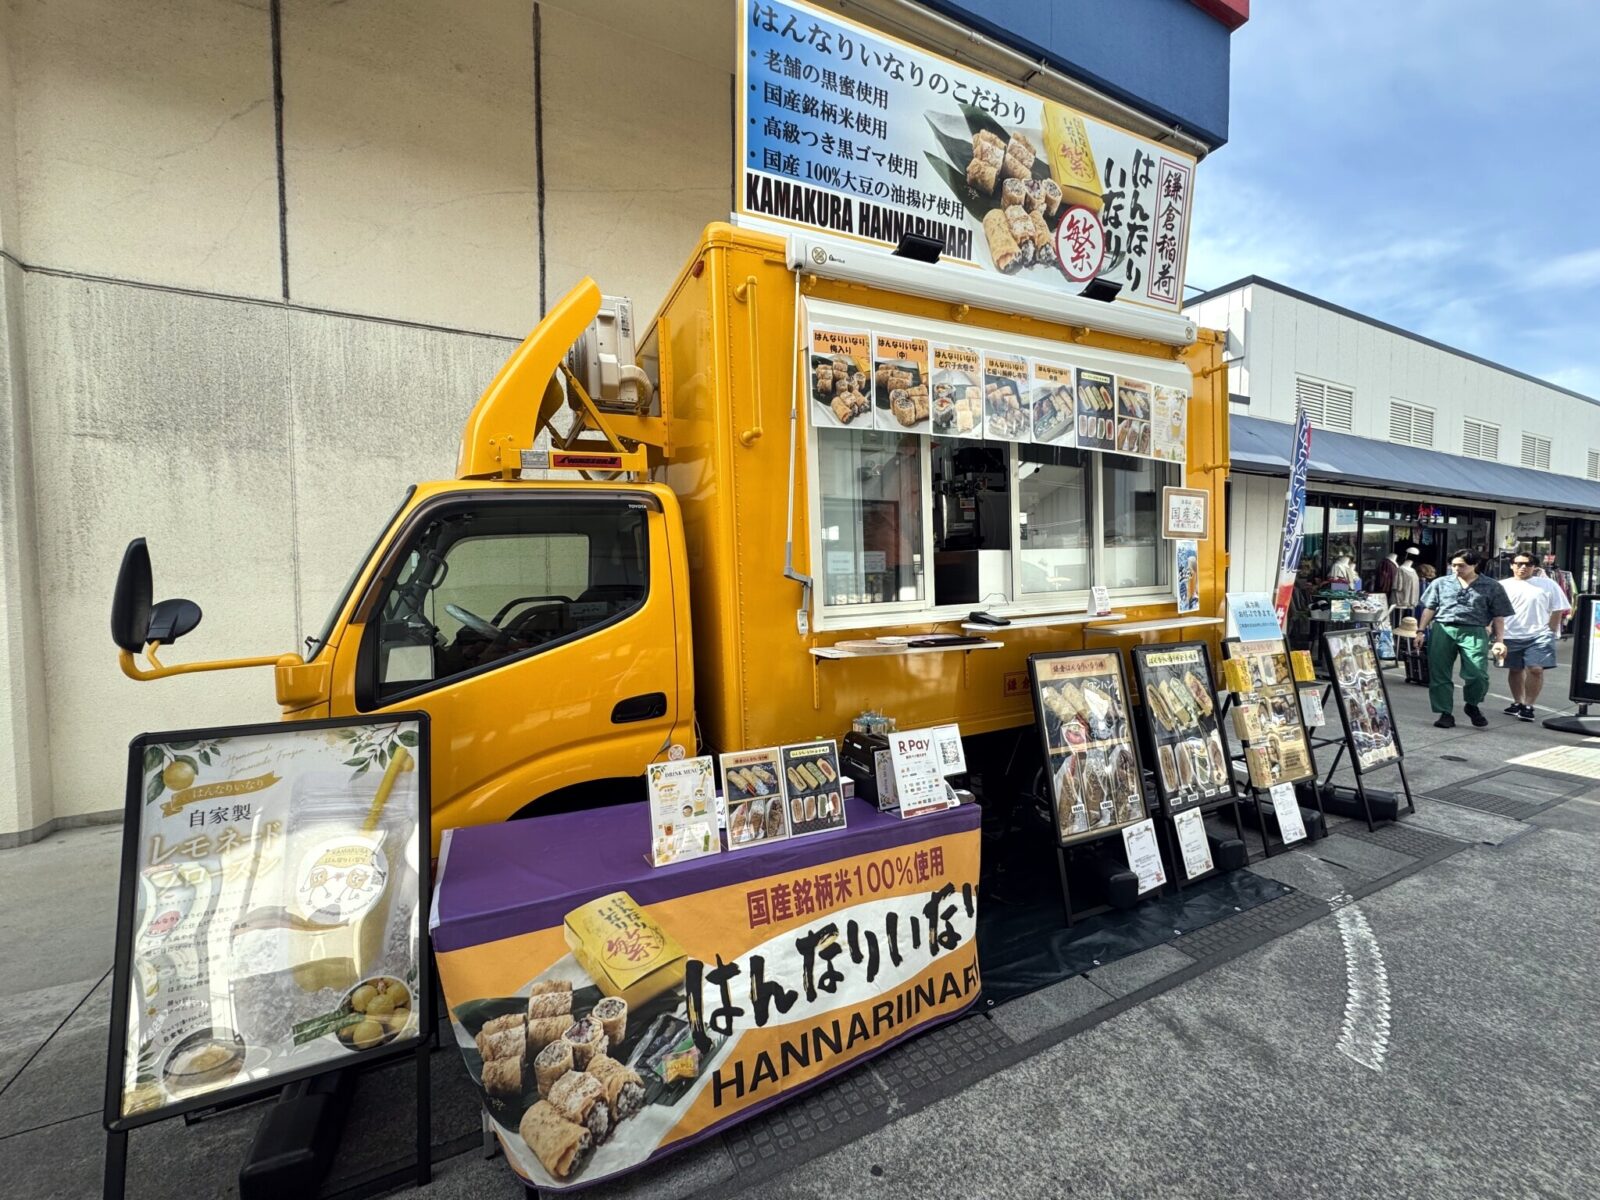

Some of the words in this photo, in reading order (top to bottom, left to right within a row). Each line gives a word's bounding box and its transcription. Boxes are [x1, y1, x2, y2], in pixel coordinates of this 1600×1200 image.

[752, 2, 1026, 125] はんなりいなりのこだわり
[763, 48, 889, 110] 老舗の黒蜜使用
[763, 80, 888, 140] 国産銘柄米使用
[763, 115, 918, 179] 高級つき黒ゴマ使用
[747, 172, 854, 234] KAMAKURA
[1100, 157, 1127, 270] いなり
[1126, 148, 1156, 292] はんなり
[1153, 169, 1184, 296] 鎌倉稲荷
[1062, 214, 1096, 273] 繁
[814, 332, 865, 347] はんなりいなり
[877, 339, 924, 353] はんなりいなり
[935, 350, 977, 364] はんなりいなり
[988, 360, 1025, 371] はんなりいなり
[664, 769, 682, 778] DRINK
[683, 767, 699, 775] MENU
[908, 739, 930, 752] Pay
[150, 821, 282, 866] レモネード
[188, 803, 252, 828] 自家製
[746, 845, 945, 930] 国産銘柄米100%使用
